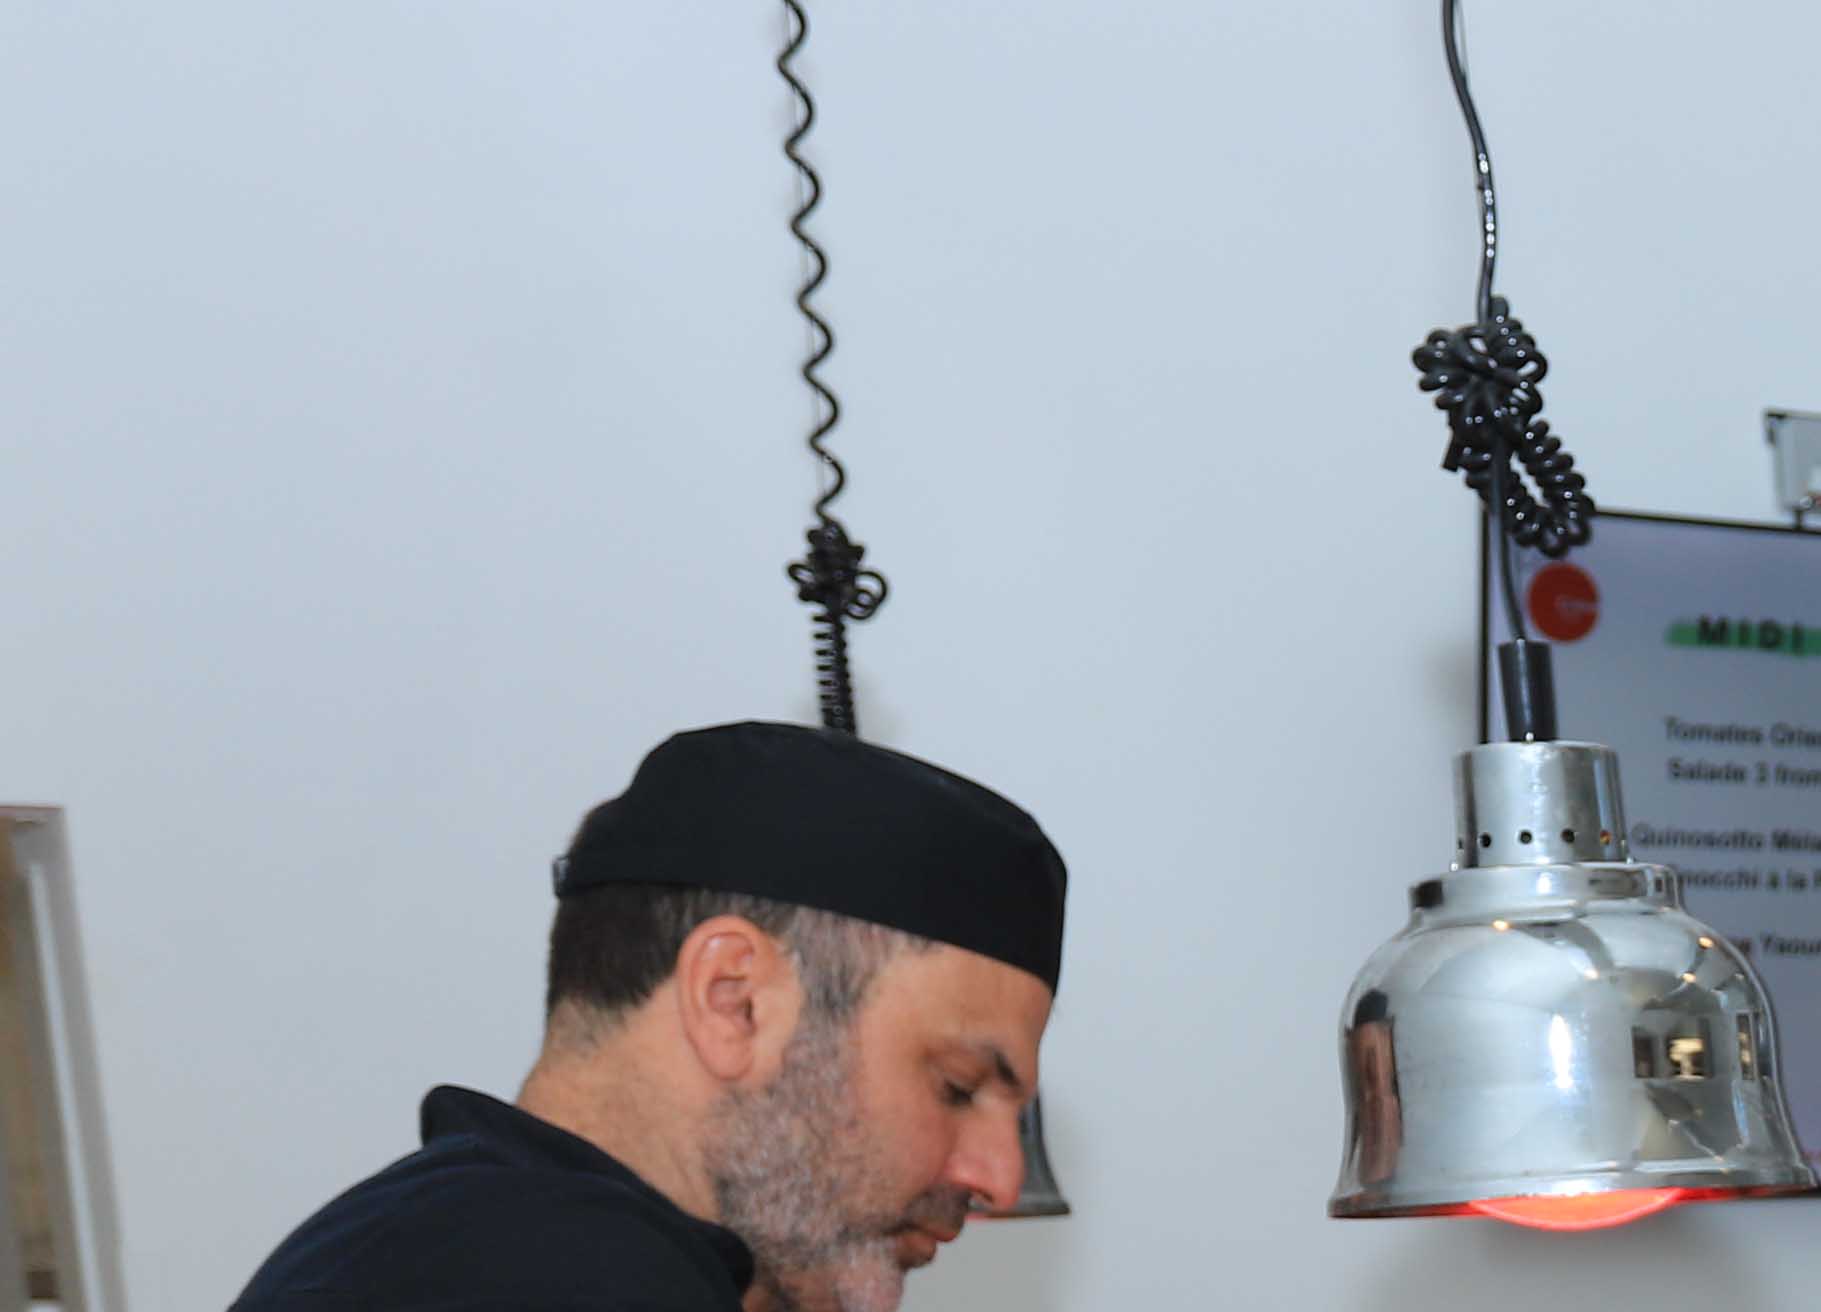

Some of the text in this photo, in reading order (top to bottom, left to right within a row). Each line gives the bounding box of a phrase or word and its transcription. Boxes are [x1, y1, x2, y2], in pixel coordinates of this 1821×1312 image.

[1697, 616, 1806, 654] MIDI
[1664, 716, 1764, 744] Tomates
[1667, 756, 1746, 784] Salade
[1677, 866, 1758, 891] nocchi
